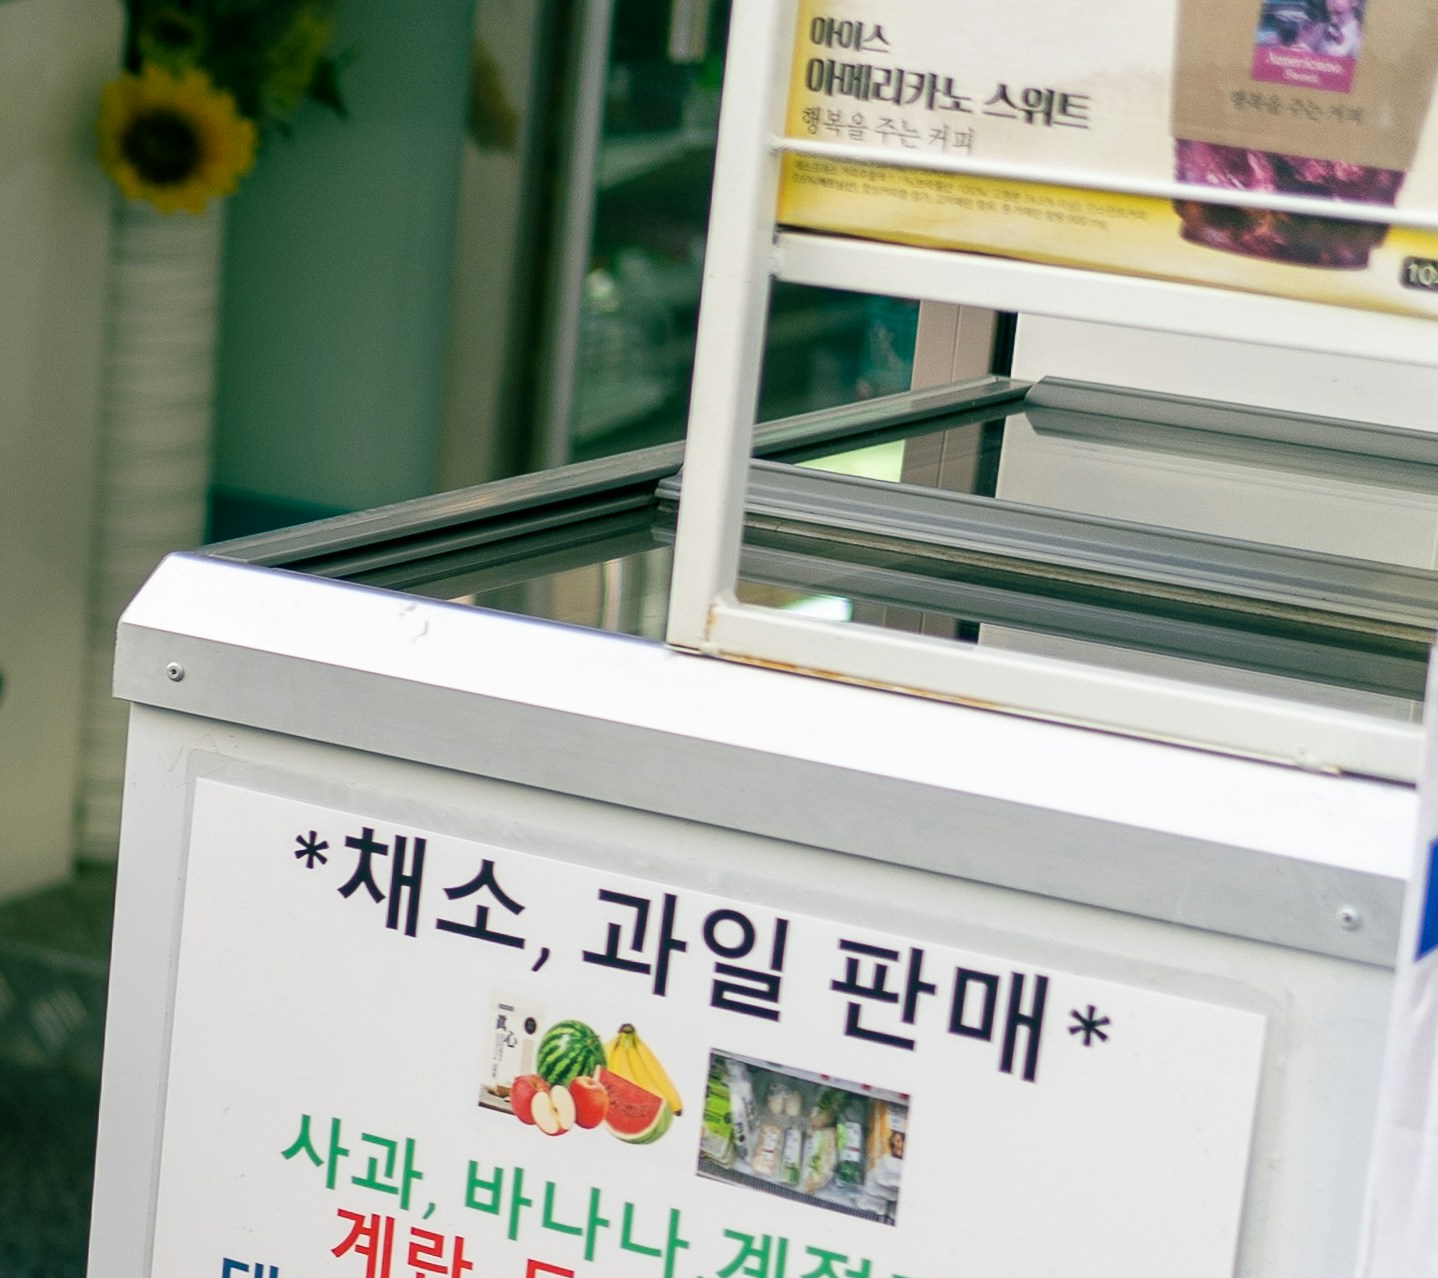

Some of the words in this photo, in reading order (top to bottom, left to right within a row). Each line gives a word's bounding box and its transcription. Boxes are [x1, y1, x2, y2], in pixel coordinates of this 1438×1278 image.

[810, 16, 891, 53] 아이스
[805, 57, 973, 114] 아메리카노
[982, 83, 1092, 130] 스위트
[802, 106, 868, 142] 행복을
[874, 117, 921, 149] 주는
[927, 124, 975, 155] 커피
[582, 889, 789, 1022] 과일
[281, 1114, 435, 1220] 사과,
